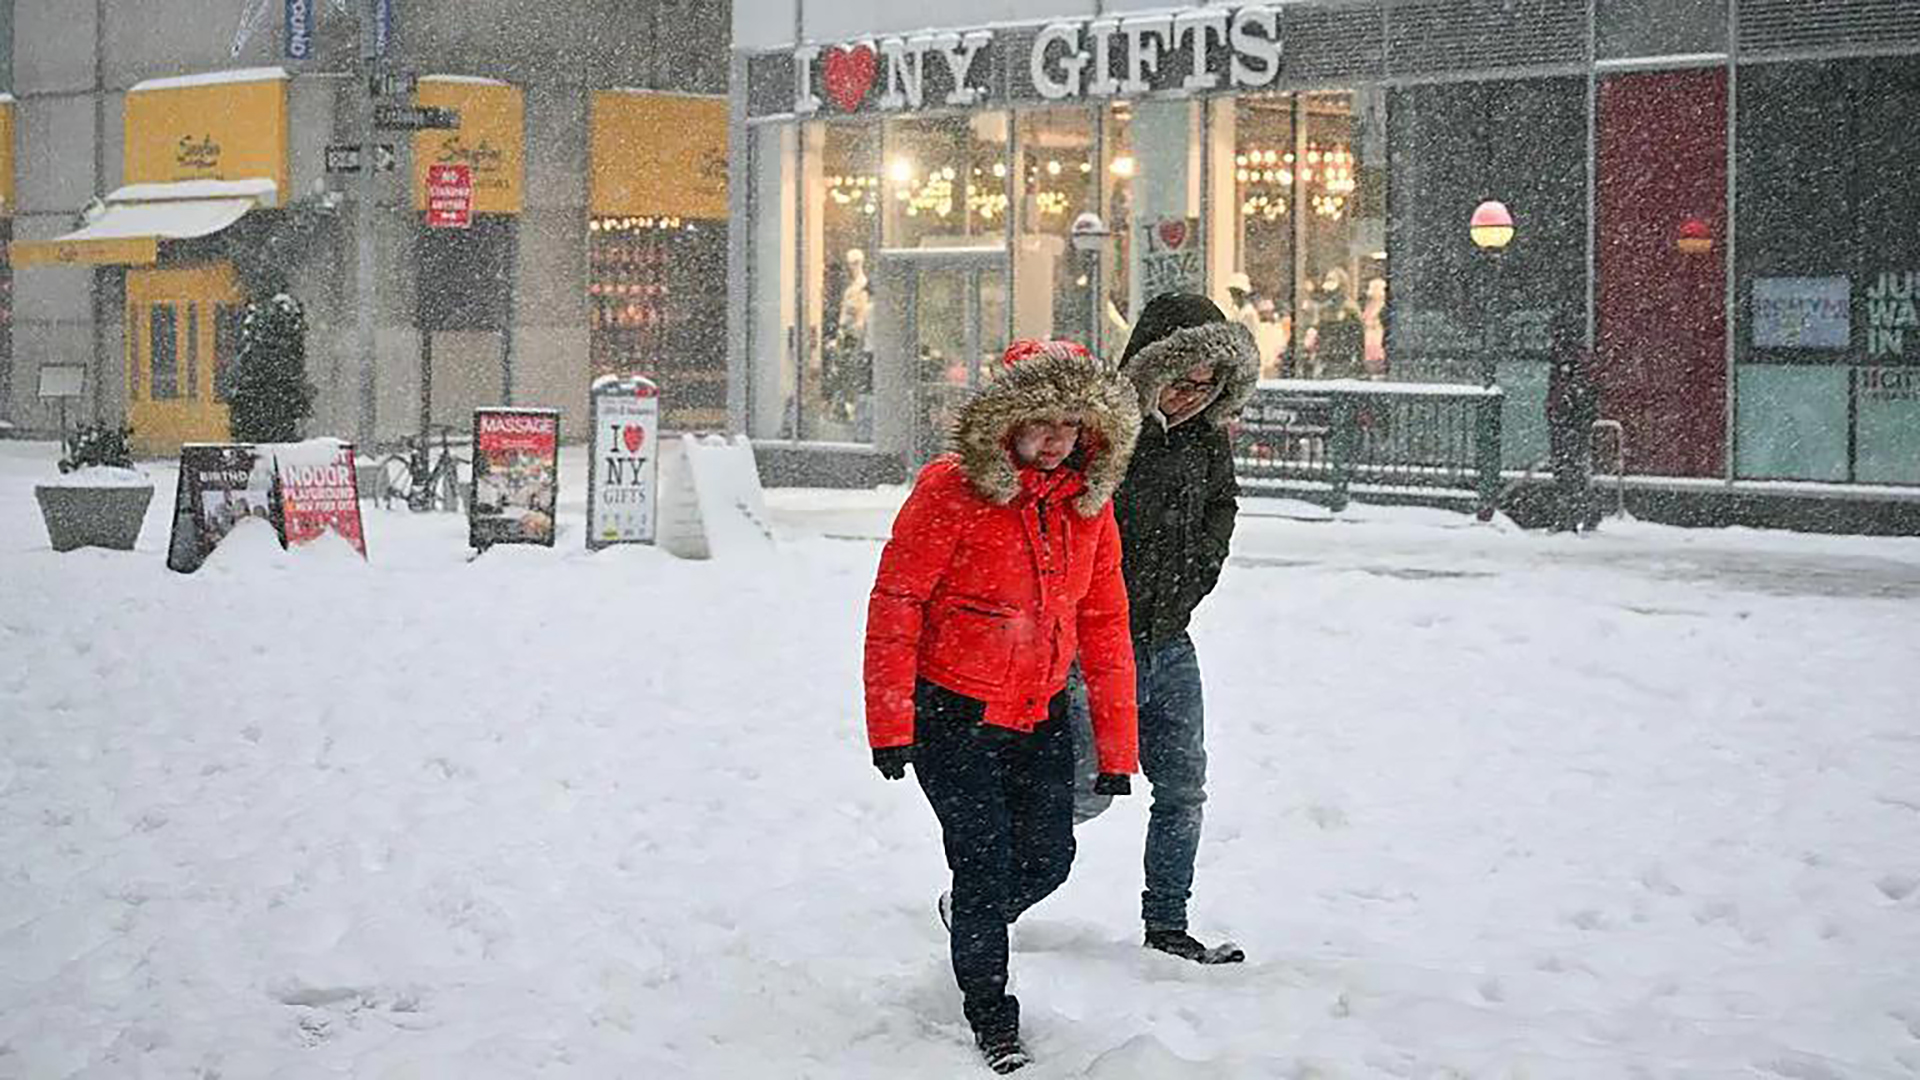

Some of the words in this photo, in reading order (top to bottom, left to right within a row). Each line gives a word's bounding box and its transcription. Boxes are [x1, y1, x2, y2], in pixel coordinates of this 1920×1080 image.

[290, 0, 308, 56] OUND
[795, 42, 821, 111] I
[879, 31, 993, 107] NY
[1032, 5, 1281, 100] GIFTS
[1867, 328, 1902, 354] IN
[480, 416, 555, 434] MASSAGE
[610, 424, 621, 453] I
[199, 470, 252, 483] BIRTHD
[280, 465, 350, 487] INDOOR
[605, 457, 646, 486] NY
[602, 487, 646, 505] GIFTS
